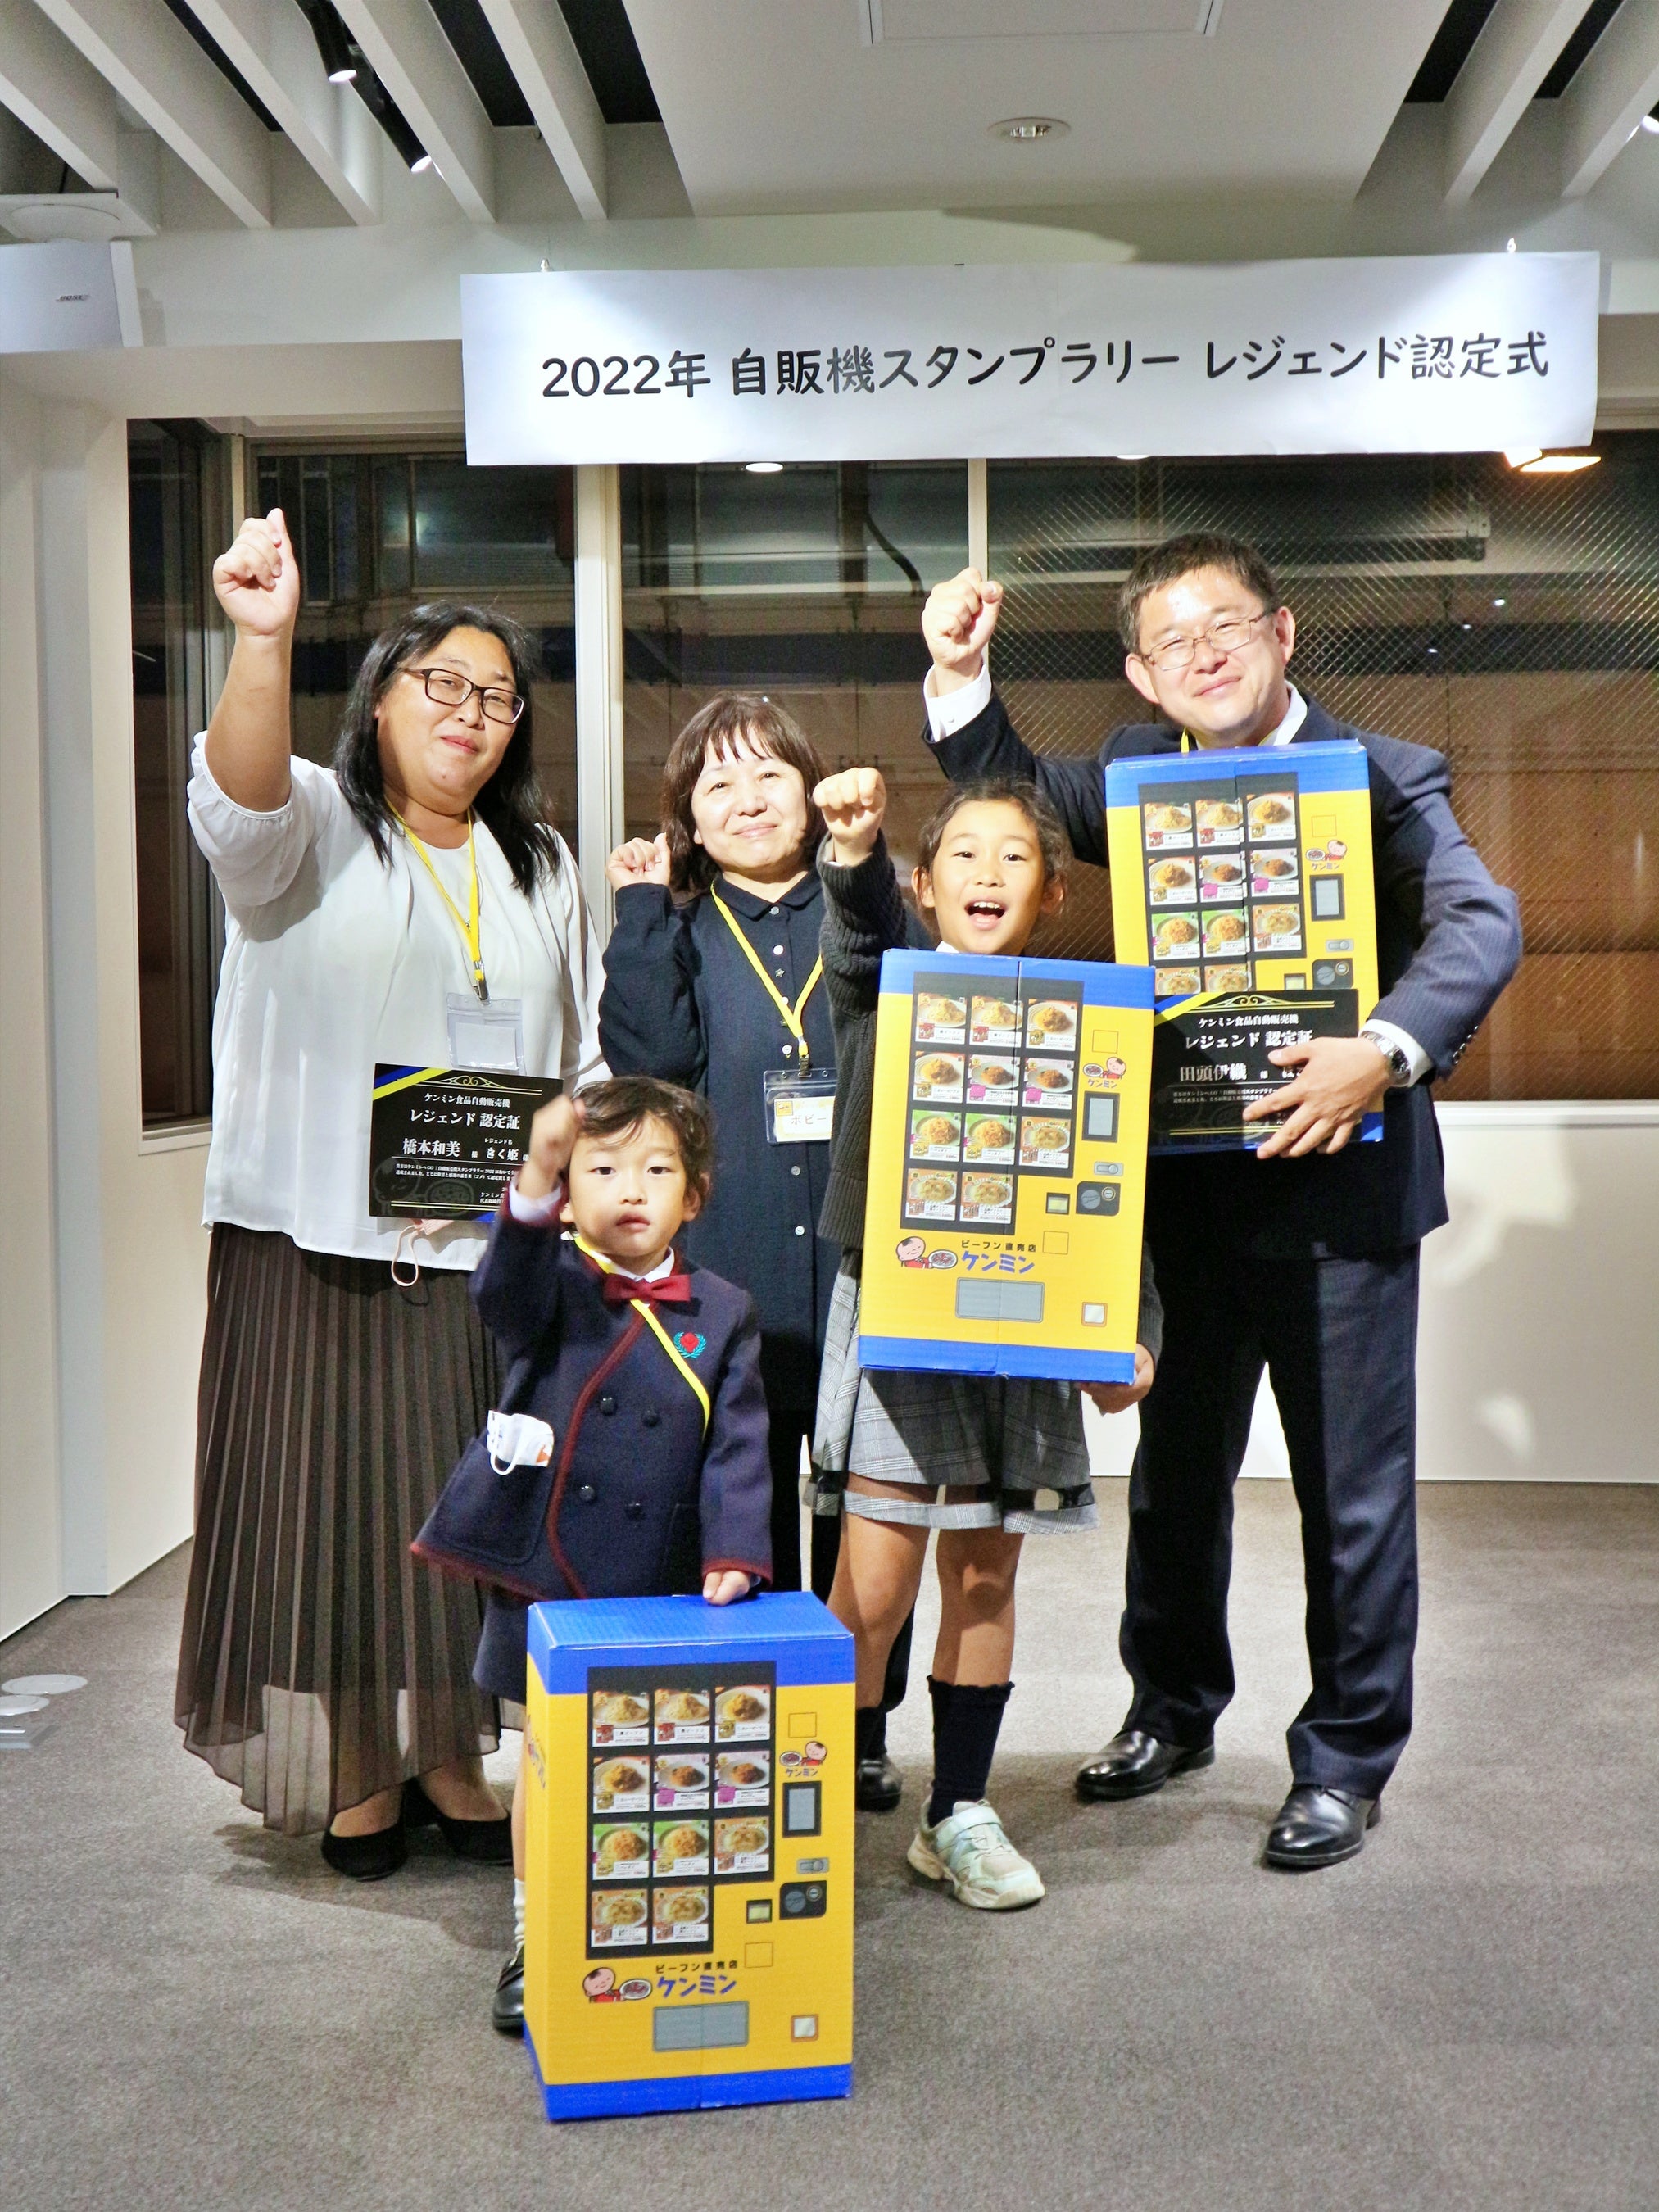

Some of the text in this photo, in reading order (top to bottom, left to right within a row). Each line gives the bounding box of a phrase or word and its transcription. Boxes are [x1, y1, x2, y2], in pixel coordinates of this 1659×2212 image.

[540, 328, 1550, 399] 2022年 自販機スタンプラリー レジェンド認定式
[1312, 863, 1340, 871] ケンミン
[1199, 1014, 1299, 1028] ケンミン食品自動販売機
[1185, 1031, 1261, 1049] レジェンド
[1087, 1078, 1118, 1089] ケンミン
[424, 1093, 510, 1108] ケンミン食品自動販売機
[410, 1108, 521, 1130] レジェンド 認定証
[403, 1138, 460, 1157] 橋本和美
[486, 1147, 518, 1160] きく姫
[961, 1239, 1037, 1253] ビーフン直売店
[961, 1250, 1036, 1274] ケンミン
[785, 1768, 818, 1778] ケンミン
[656, 1974, 737, 1997] ケンミン
